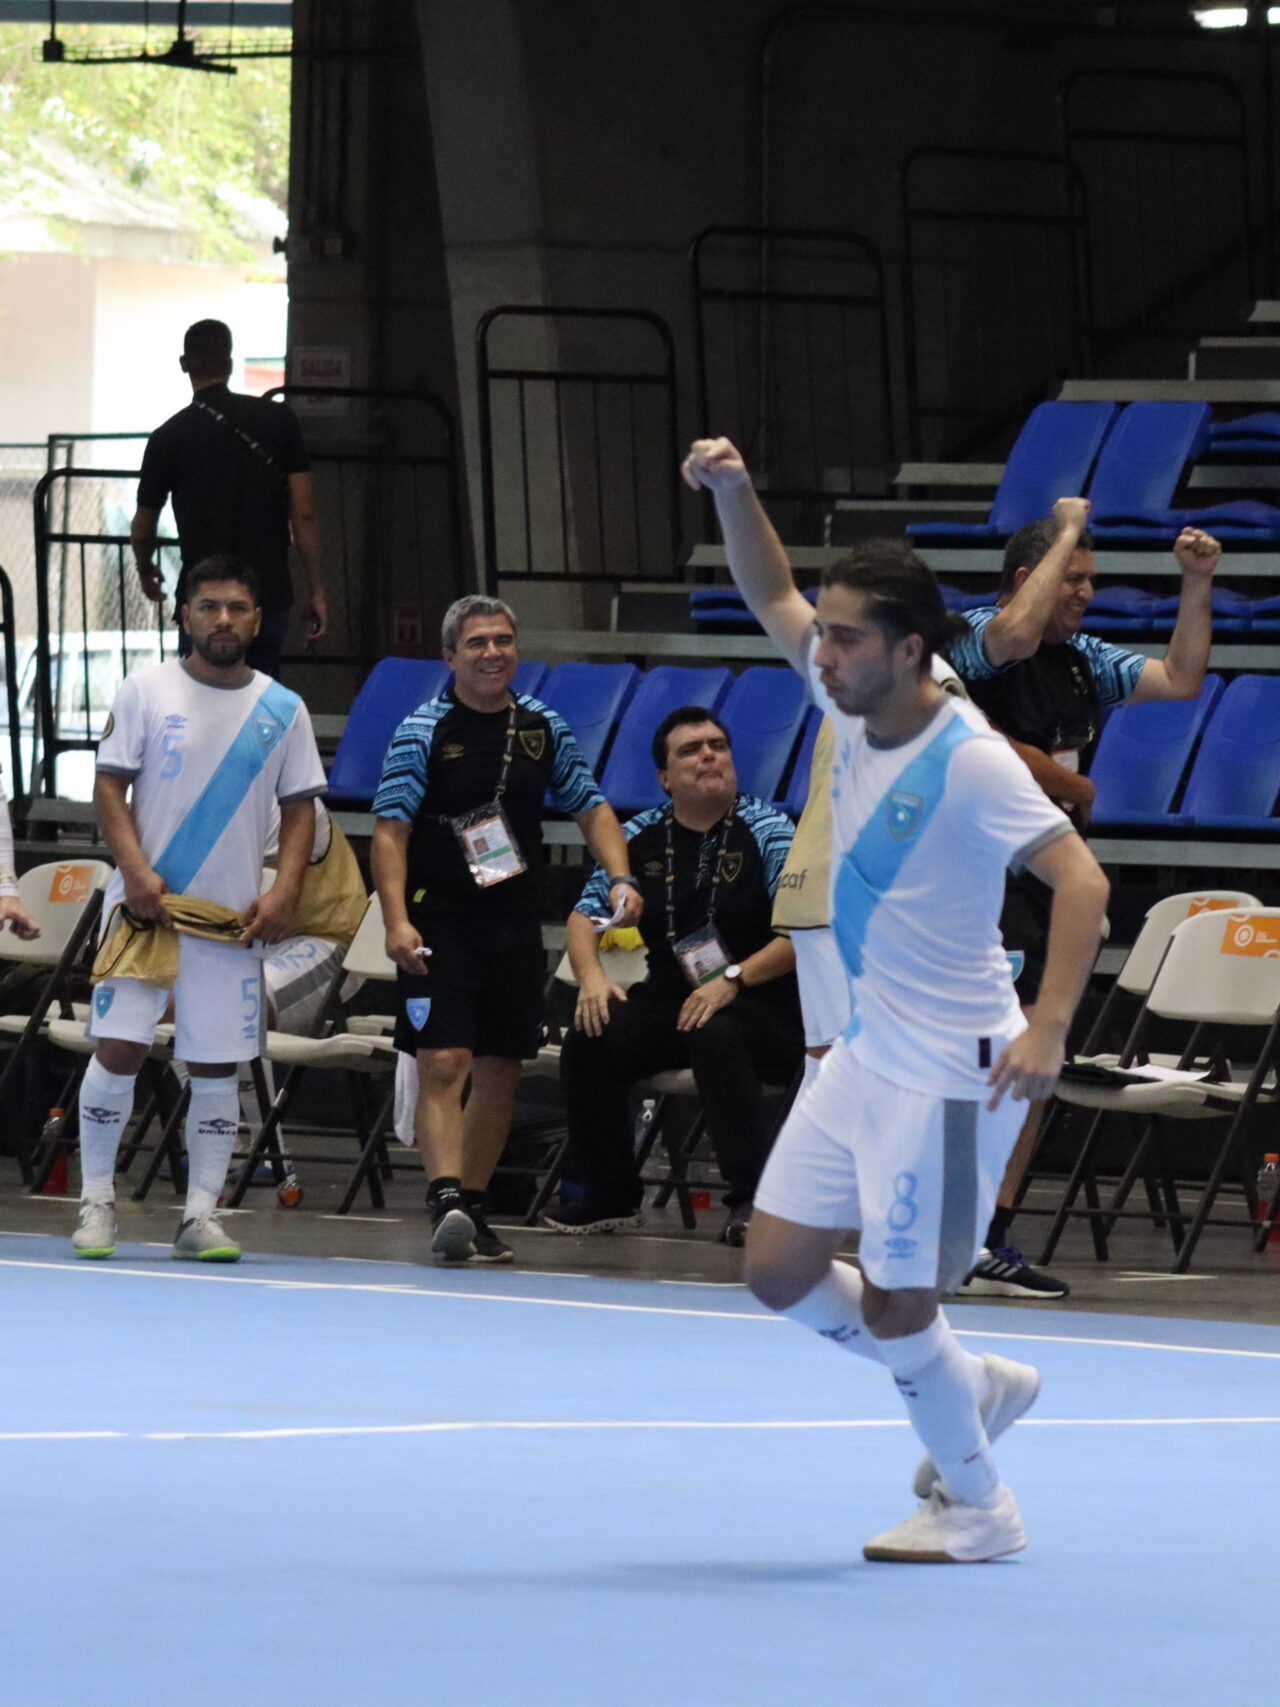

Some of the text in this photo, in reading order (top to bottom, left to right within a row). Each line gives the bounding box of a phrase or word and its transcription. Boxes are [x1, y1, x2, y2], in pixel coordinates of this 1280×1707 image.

[160, 733, 184, 779] 5
[241, 977, 259, 1022] 5
[886, 1169, 919, 1232] 8
